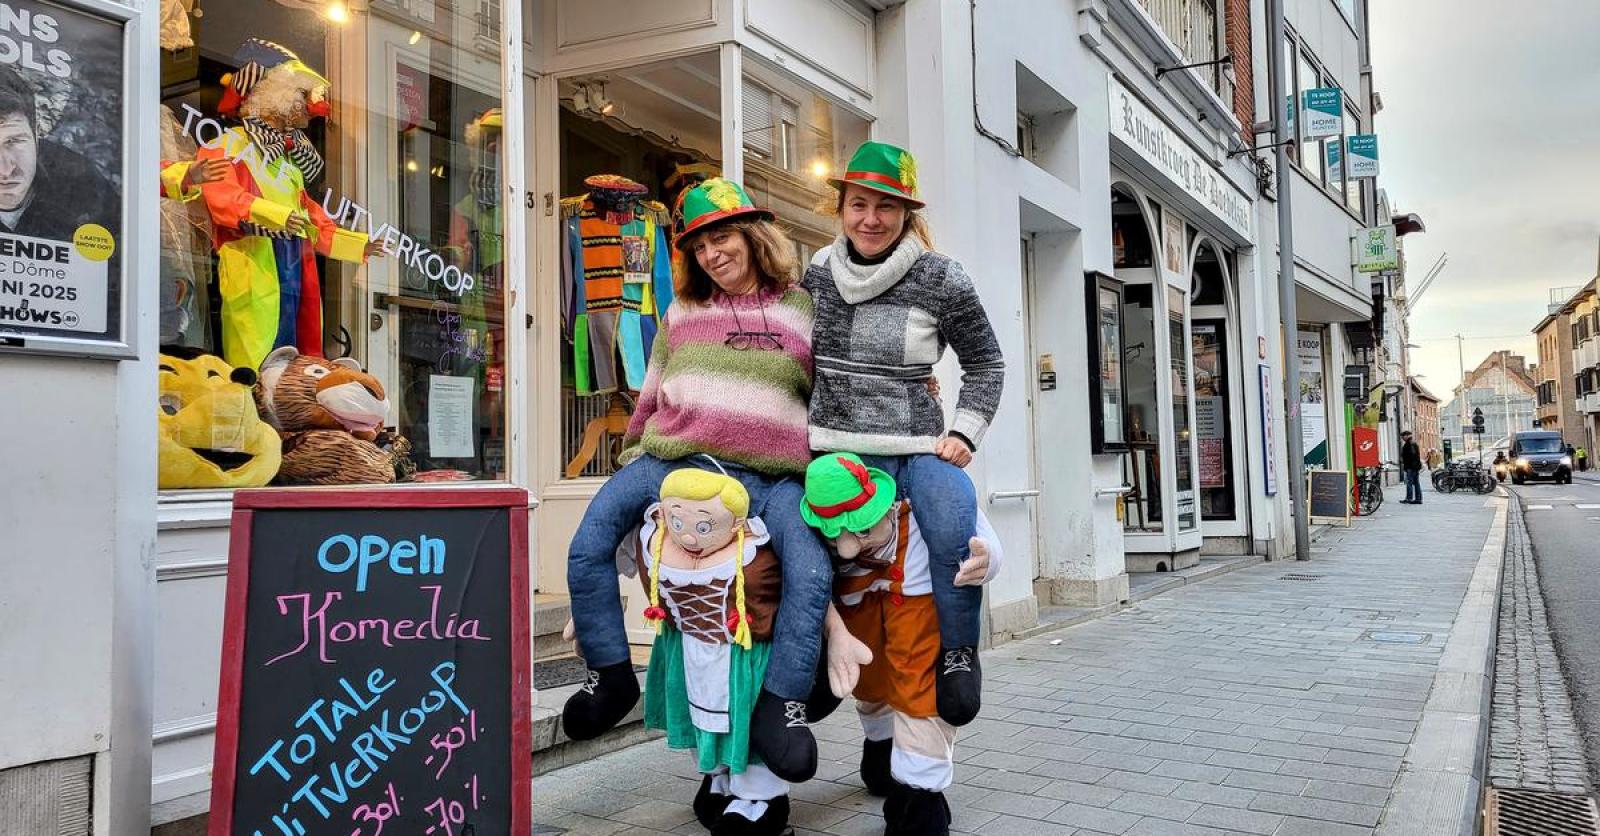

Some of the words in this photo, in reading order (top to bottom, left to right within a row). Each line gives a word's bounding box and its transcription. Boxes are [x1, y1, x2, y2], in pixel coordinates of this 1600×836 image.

[0, 2, 59, 43] NS
[1121, 92, 1191, 191] Kunstkroeg
[1191, 156, 1207, 197] De
[181, 102, 300, 193] TOTALE
[322, 187, 475, 297] UITVERKOOP
[13, 260, 66, 280] Dôme
[29, 282, 77, 301] 2025
[264, 583, 493, 667] Komedia
